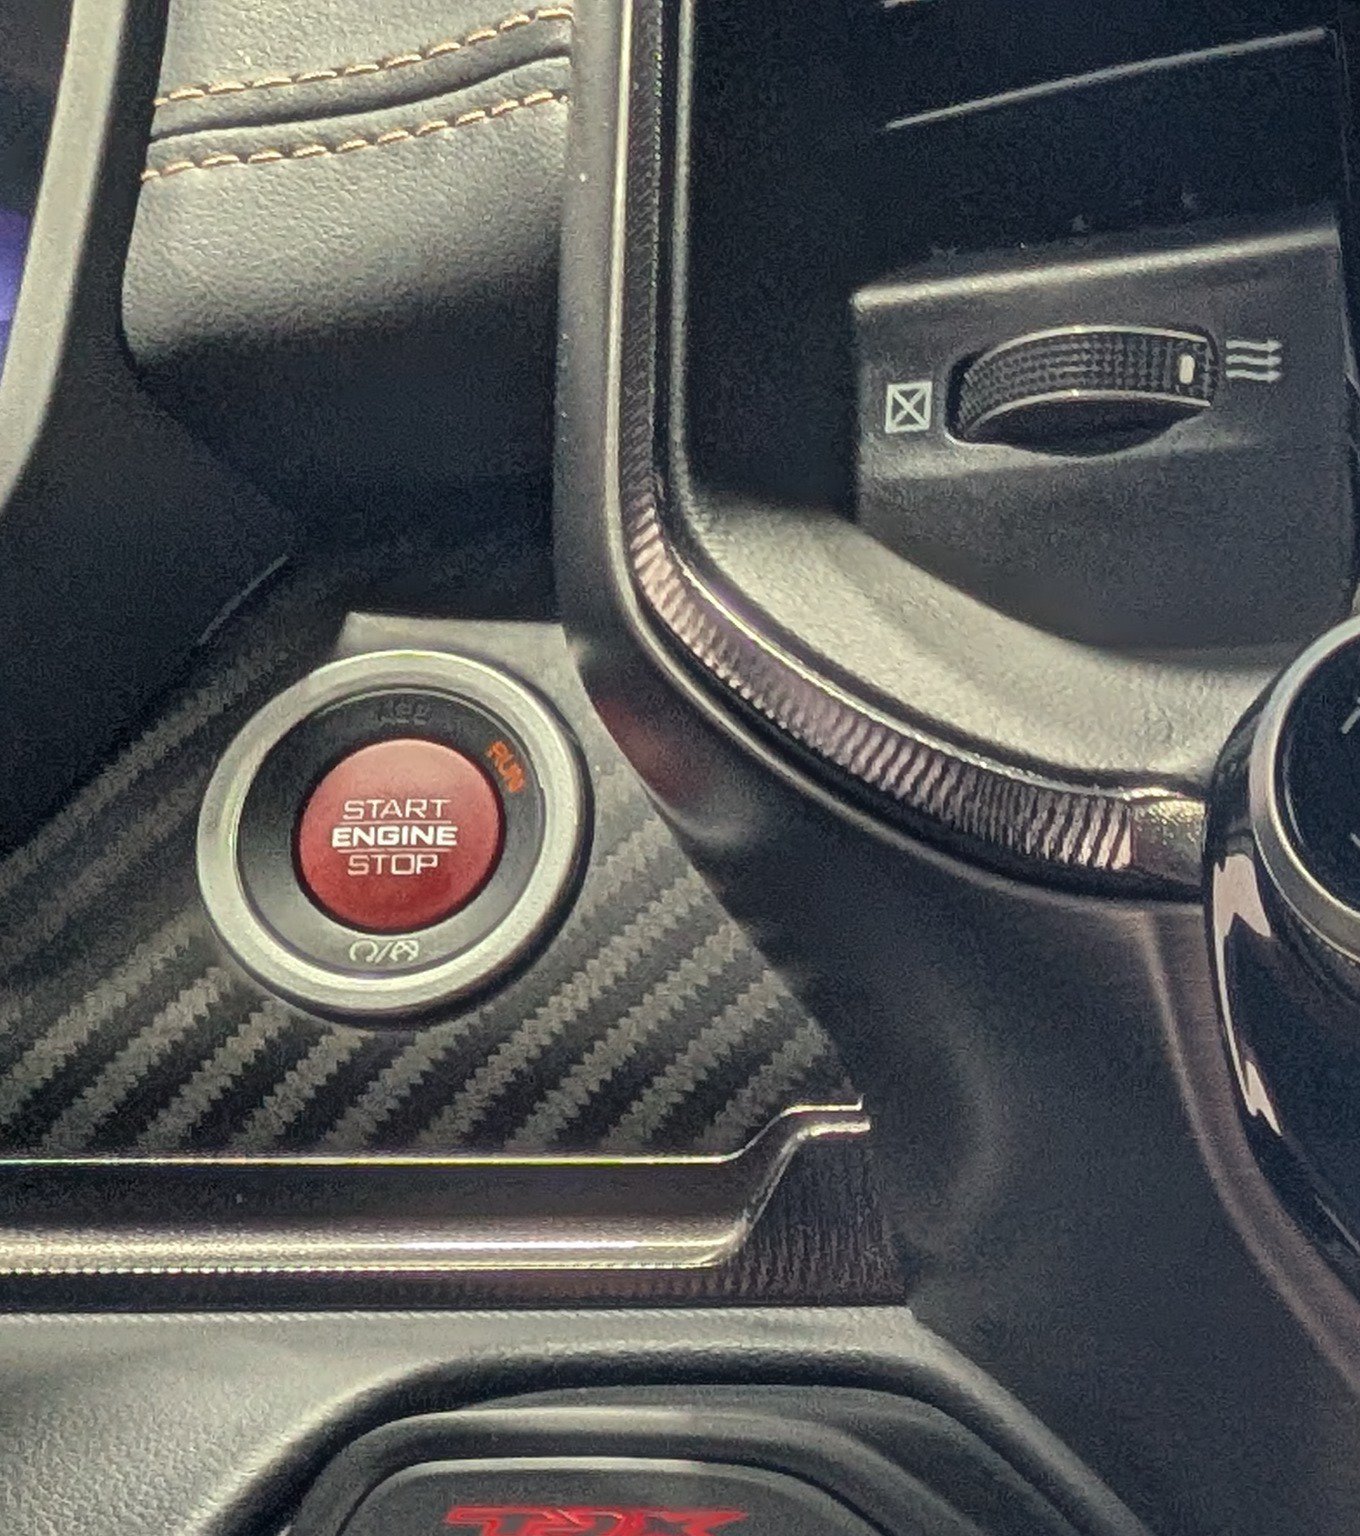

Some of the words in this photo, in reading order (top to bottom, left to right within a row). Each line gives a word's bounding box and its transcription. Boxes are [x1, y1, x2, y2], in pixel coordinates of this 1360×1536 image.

[342, 798, 451, 821] START
[332, 825, 459, 849] ENGINE
[347, 852, 439, 877] STOP
